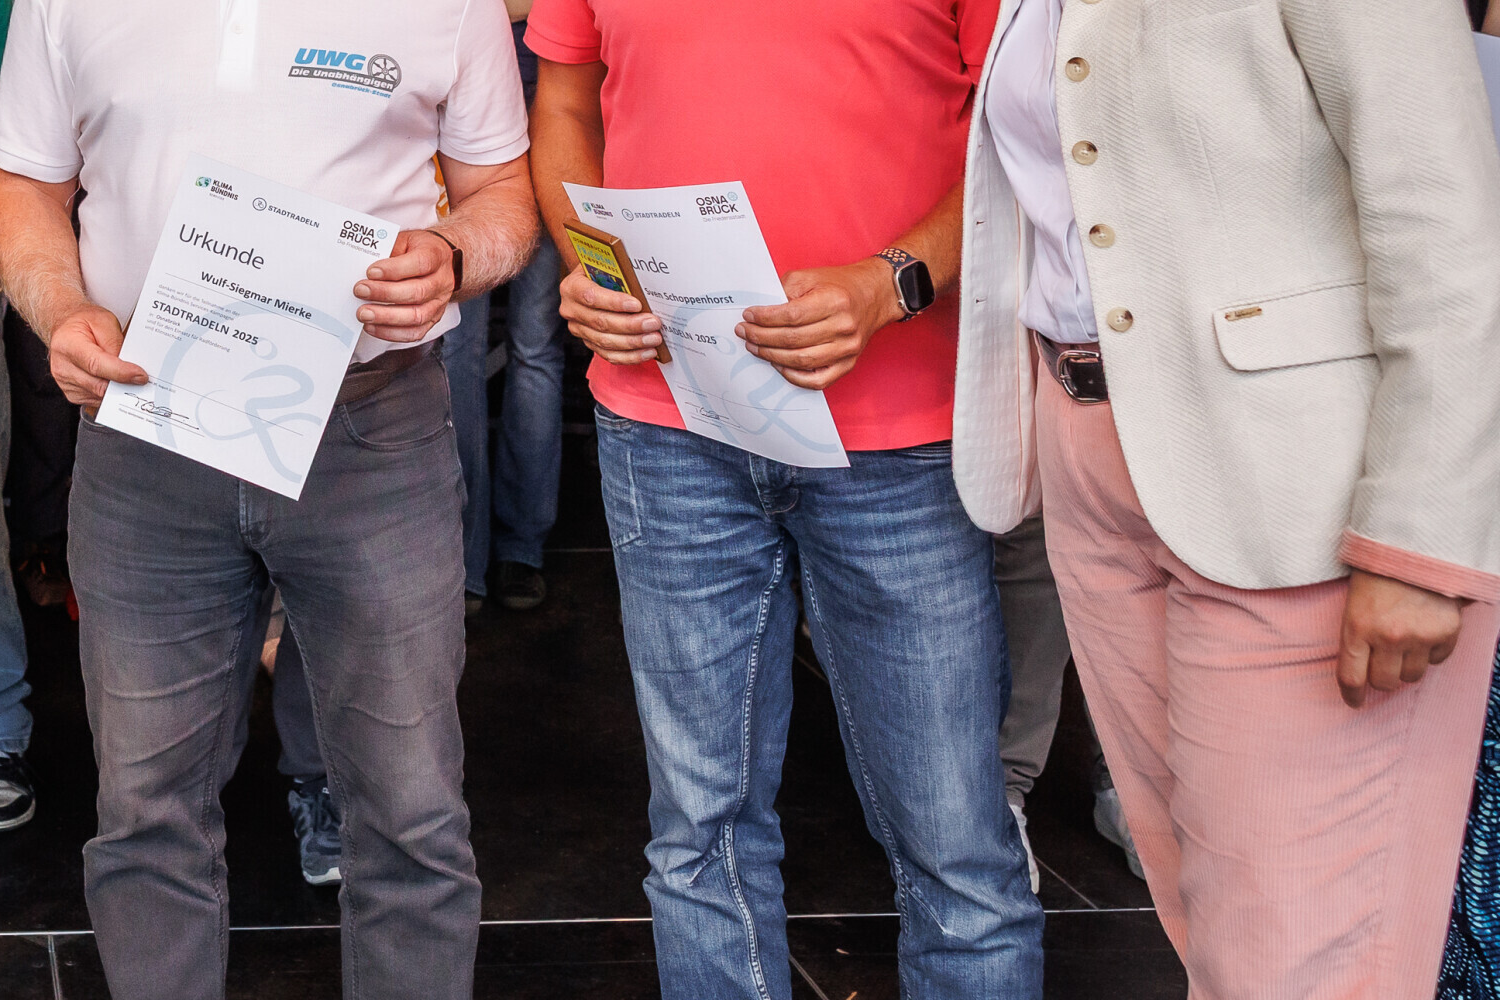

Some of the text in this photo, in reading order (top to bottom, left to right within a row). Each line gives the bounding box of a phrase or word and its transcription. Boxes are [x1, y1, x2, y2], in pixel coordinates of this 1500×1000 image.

[294, 47, 367, 71] UWG
[291, 68, 394, 90] Die Unabhängigen
[211, 186, 238, 200] BÜNDNIS
[213, 180, 232, 191] KLIMA
[695, 195, 728, 206] OSNA
[698, 203, 738, 216] BRÜCK
[268, 206, 319, 228] STADTRADELN
[634, 211, 680, 219] STADTRADELN
[340, 228, 379, 249] BRÜCK
[344, 221, 374, 238] OSNA
[180, 224, 264, 269] Urkunde
[629, 256, 669, 274] unde
[202, 272, 311, 319] Wulf-Siegmar Mierke
[644, 287, 734, 305] Sven Schoppenhorst
[153, 301, 258, 345] STADTRADELN 2025
[660, 324, 717, 345] TRADELN 2025
